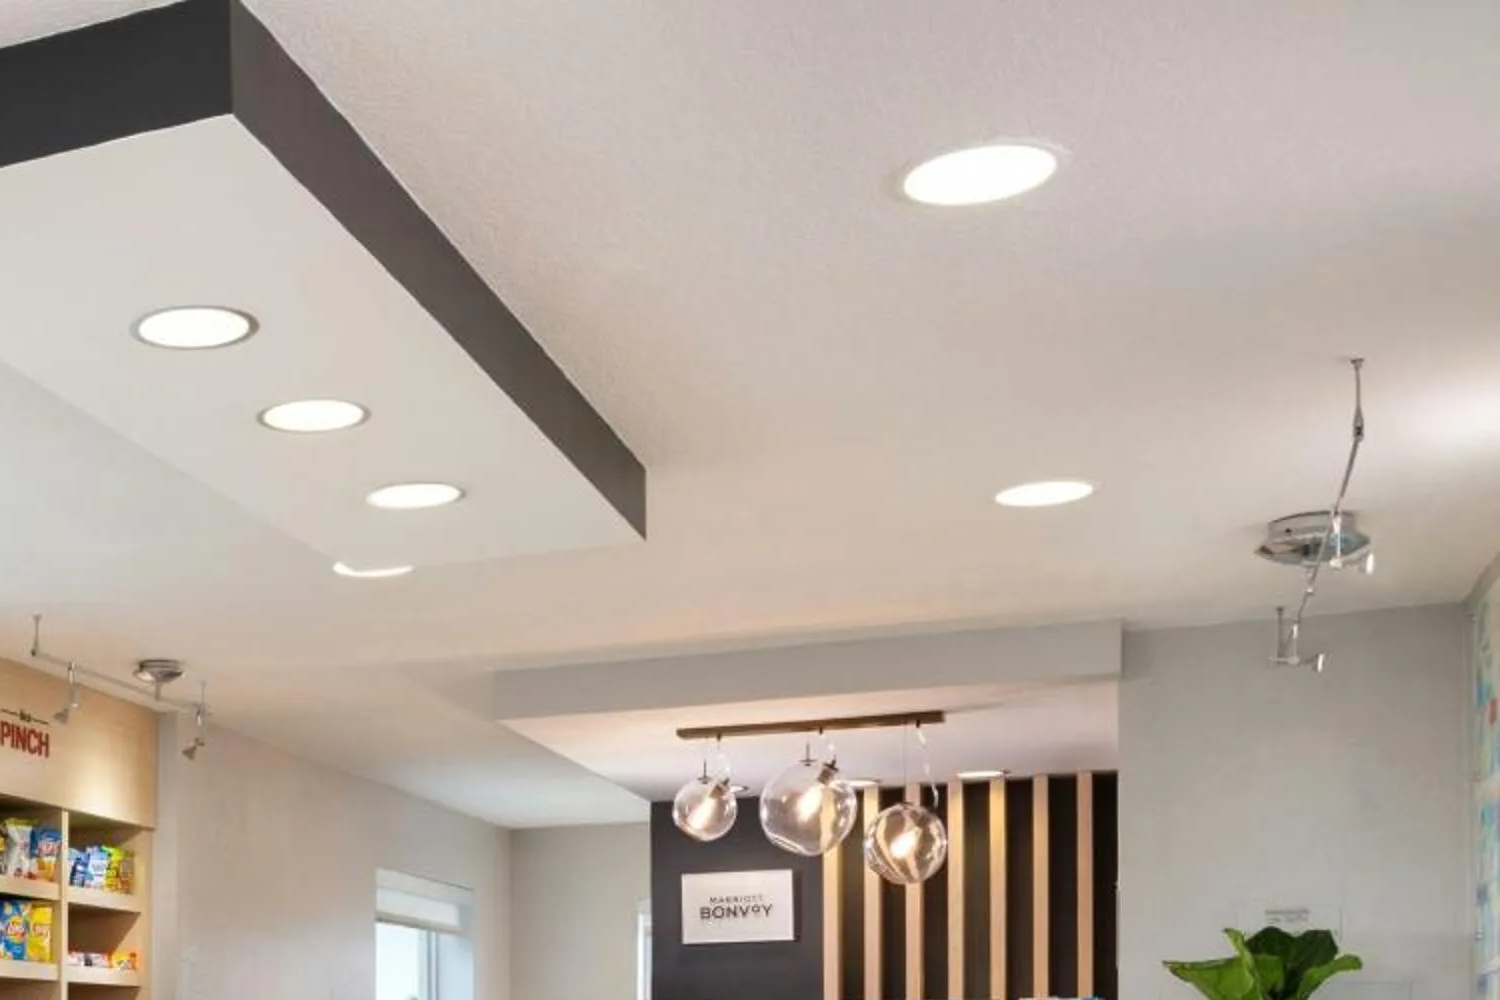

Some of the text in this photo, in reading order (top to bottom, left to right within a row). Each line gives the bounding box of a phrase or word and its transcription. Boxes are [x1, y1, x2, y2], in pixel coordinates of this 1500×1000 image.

[0, 720, 50, 758] PINCH
[710, 895, 763, 903] MARRIOTT
[700, 903, 773, 920] BONVOY
